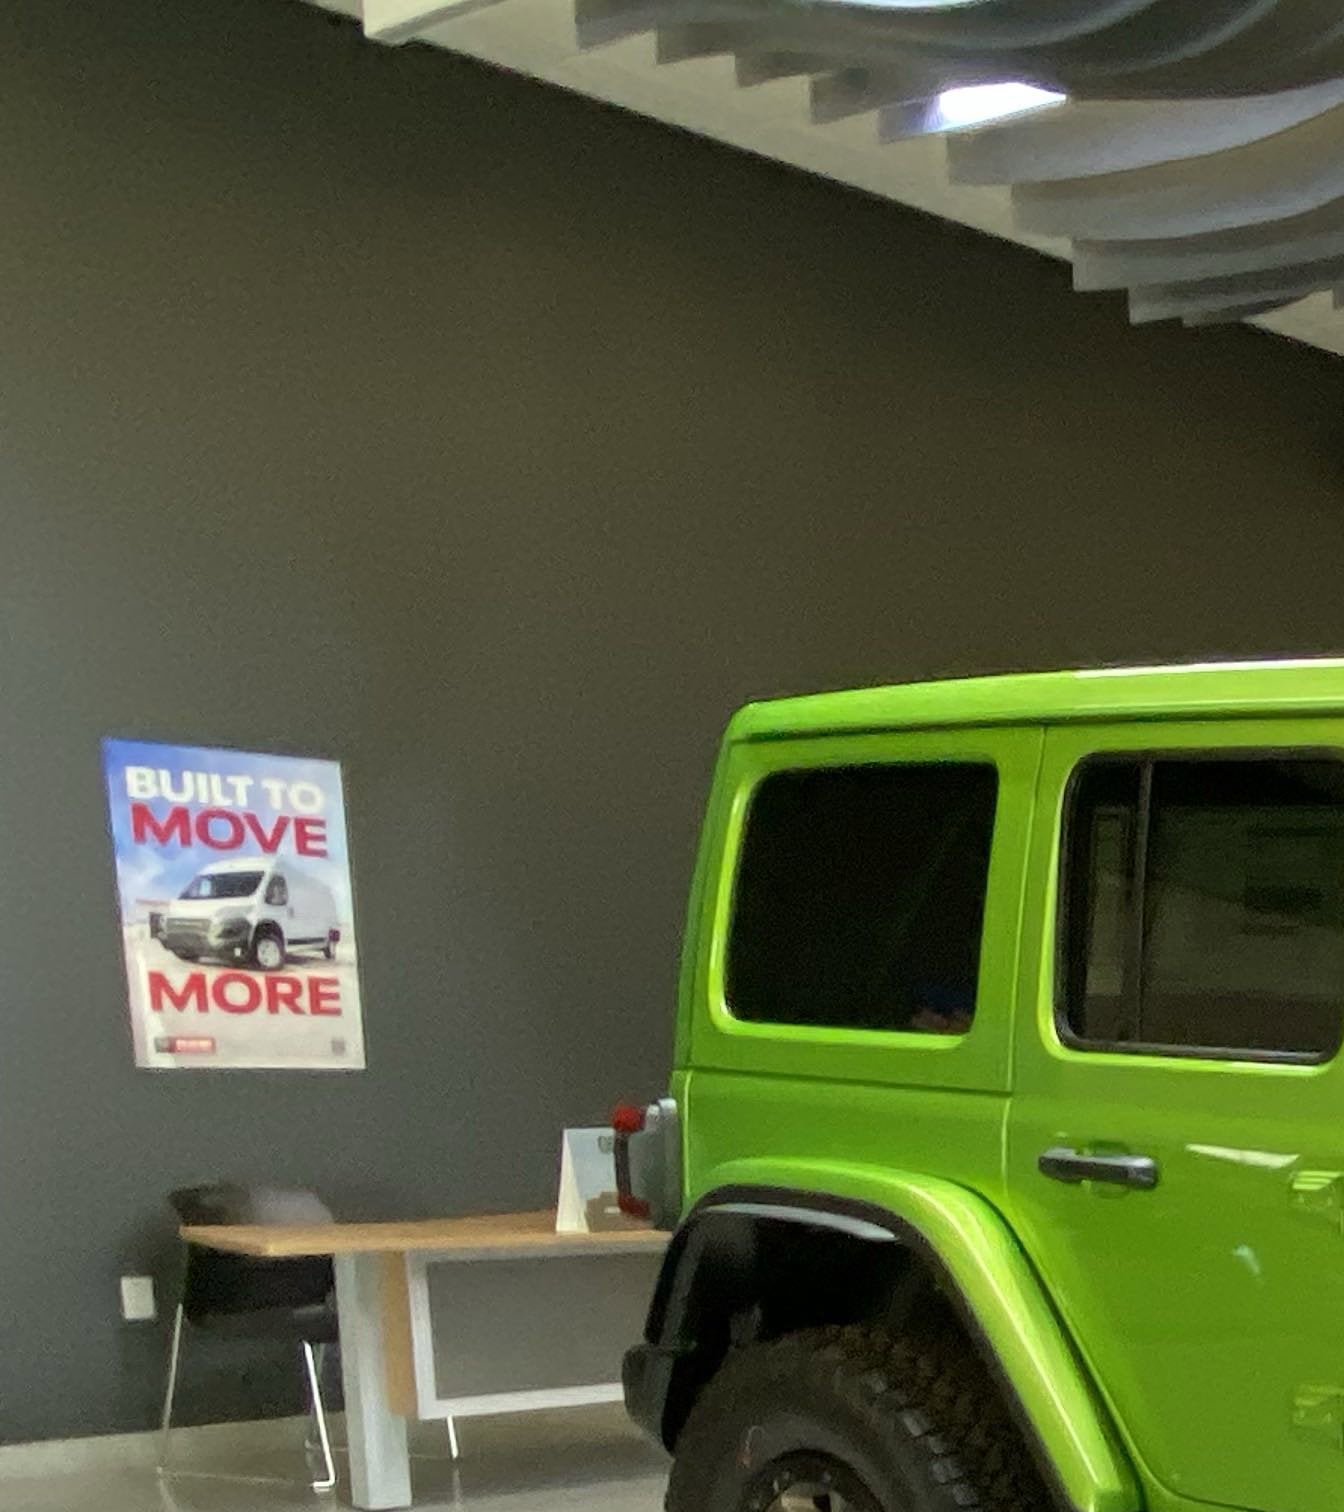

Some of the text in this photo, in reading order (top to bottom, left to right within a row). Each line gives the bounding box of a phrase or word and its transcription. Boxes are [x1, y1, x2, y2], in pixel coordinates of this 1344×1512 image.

[125, 765, 326, 815] BUILT TO
[130, 802, 329, 858] MOVE
[148, 968, 343, 1017] MORE
